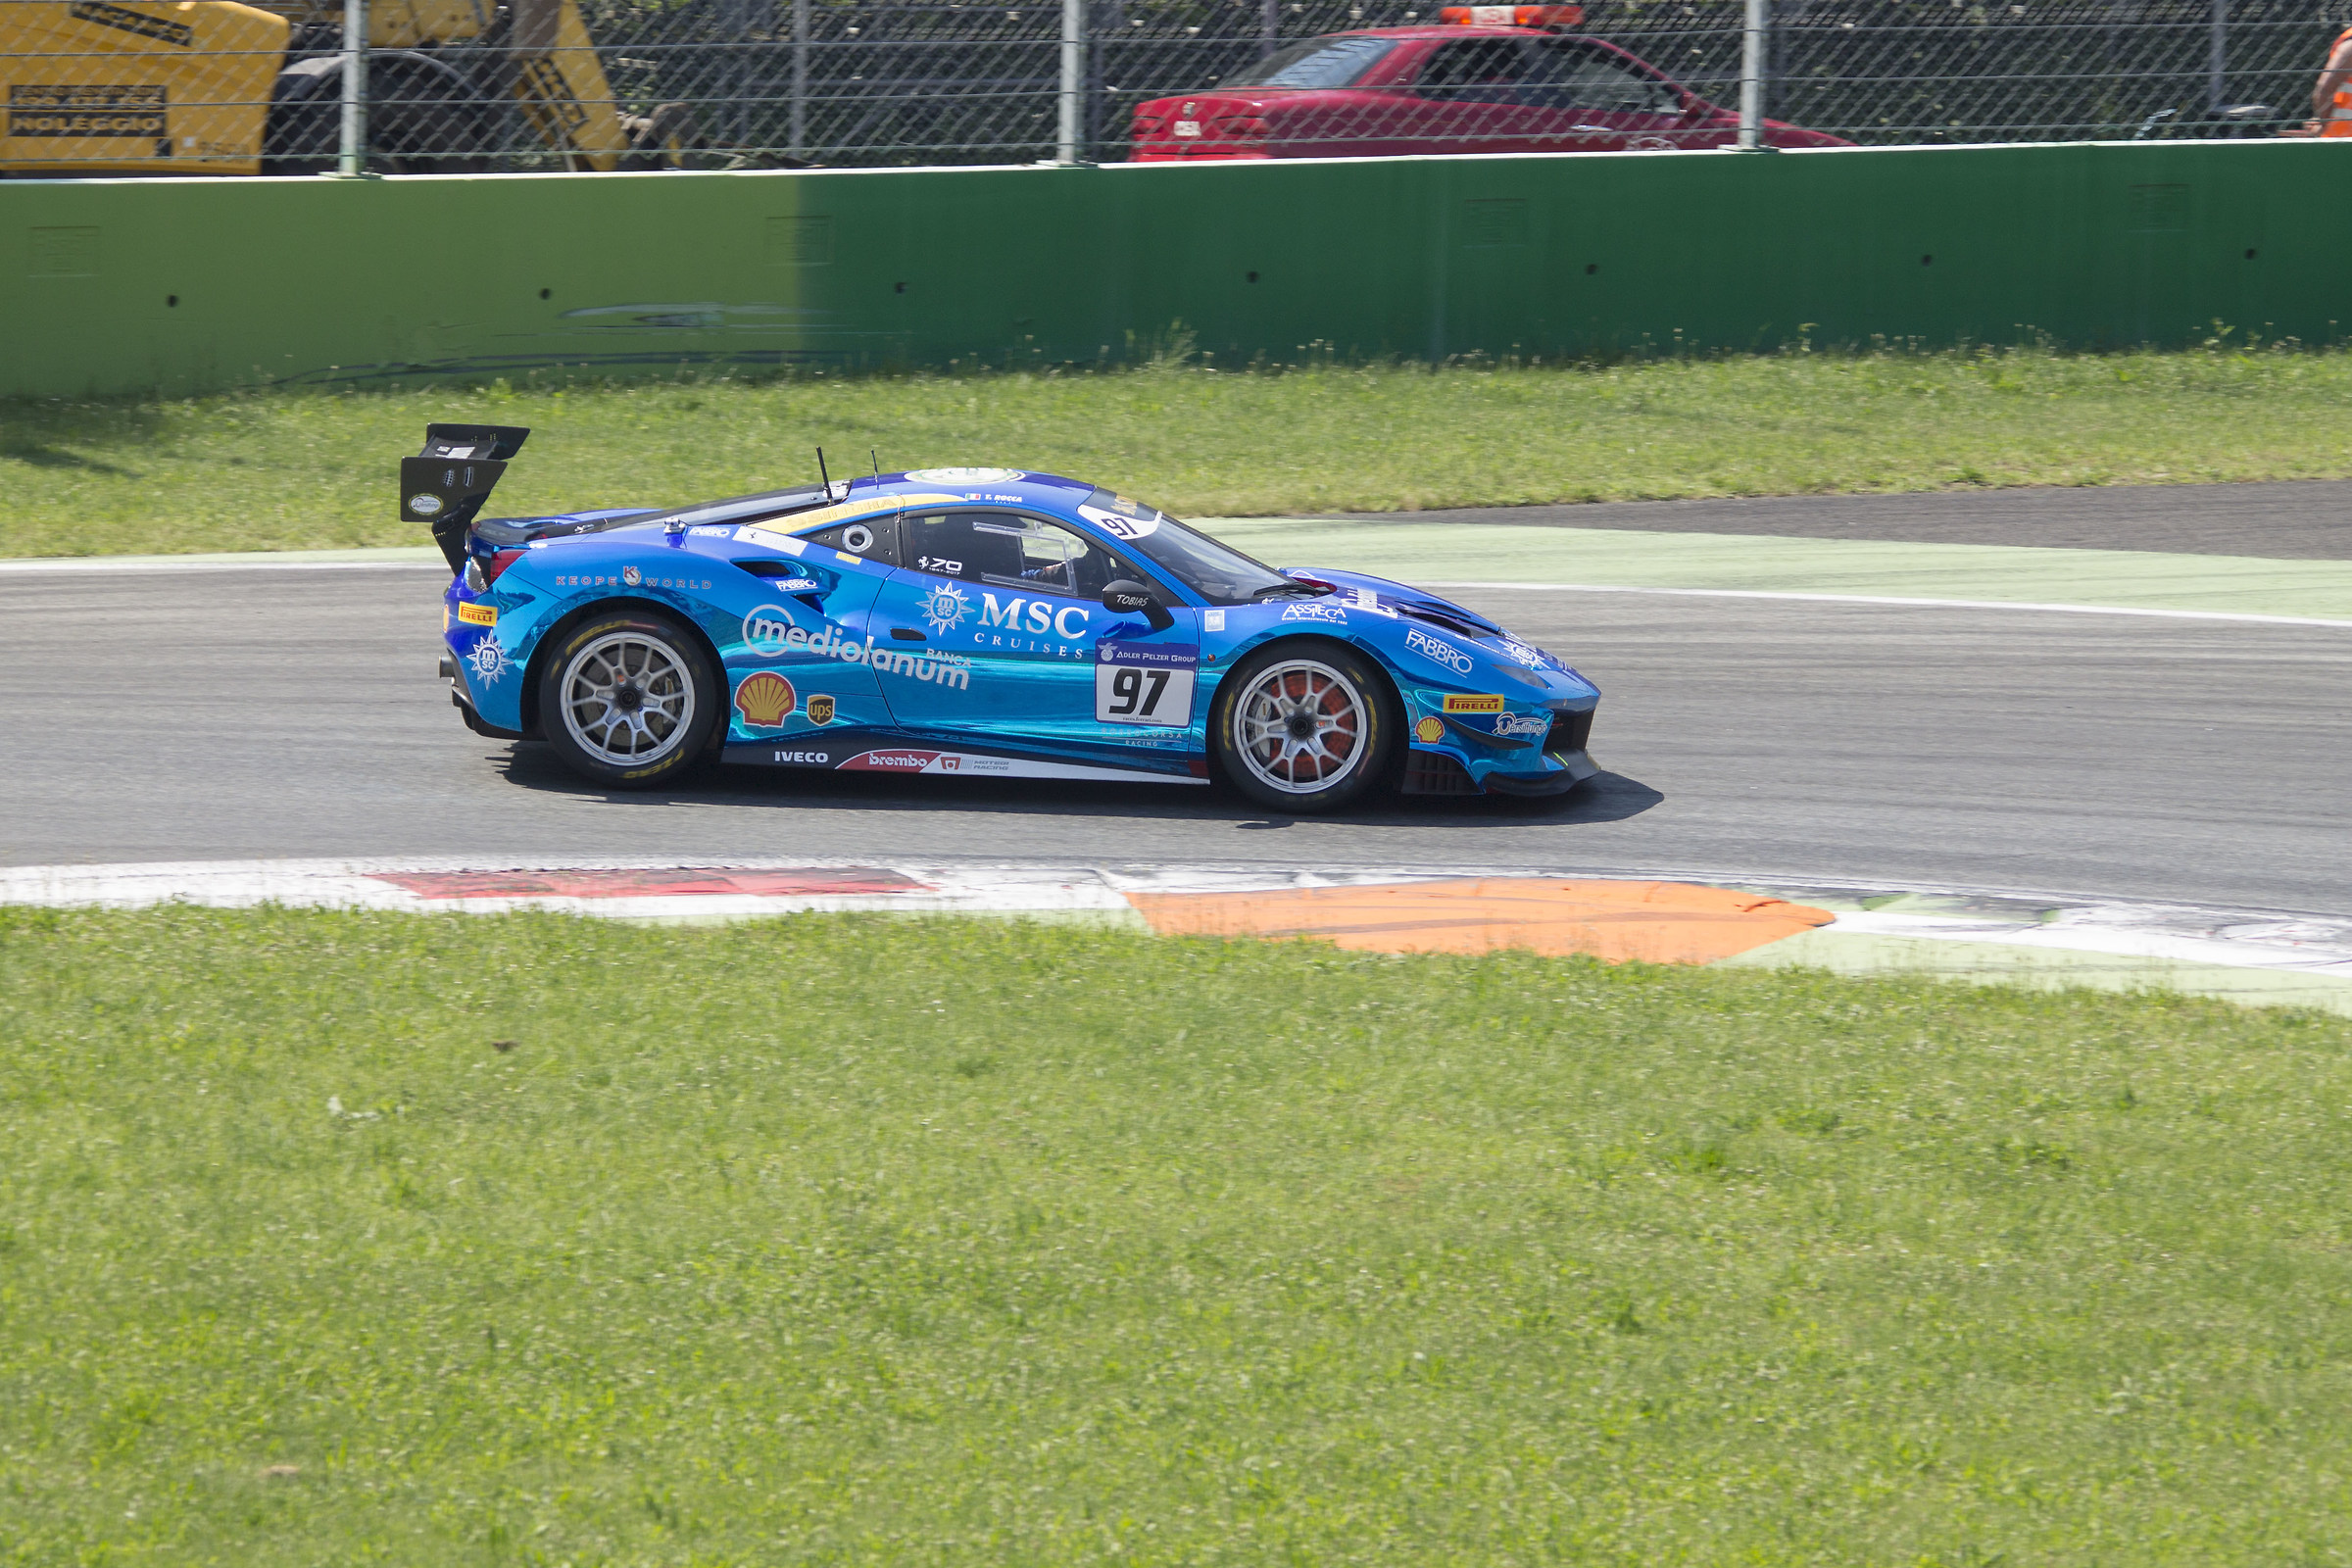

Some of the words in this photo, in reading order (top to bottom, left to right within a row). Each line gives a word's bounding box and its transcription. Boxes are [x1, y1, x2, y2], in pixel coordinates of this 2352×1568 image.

[12, 117, 164, 131] NOLEGGIO
[994, 494, 1023, 503] ROCCA
[688, 526, 731, 538] FABBRO
[1101, 516, 1139, 537] 97
[930, 557, 962, 572] 70
[556, 575, 617, 586] KEOPE
[645, 576, 712, 589] WORLD
[774, 578, 818, 591] FABBRO
[1115, 594, 1150, 607] TOBIAS
[461, 605, 493, 622] PIRELLI
[976, 592, 1091, 640] MSC
[974, 632, 1083, 660] CRUISES
[1405, 630, 1473, 674] FABBRO
[751, 617, 970, 691] mediolanum
[925, 647, 972, 668] BANCA
[1116, 651, 1141, 660] ADLER
[1143, 653, 1169, 662] PELZER
[1108, 667, 1171, 716] 97
[1448, 698, 1499, 710] PIRELLI
[809, 702, 833, 721] ups
[774, 751, 829, 763] IVECO
[868, 753, 928, 767] brembo
